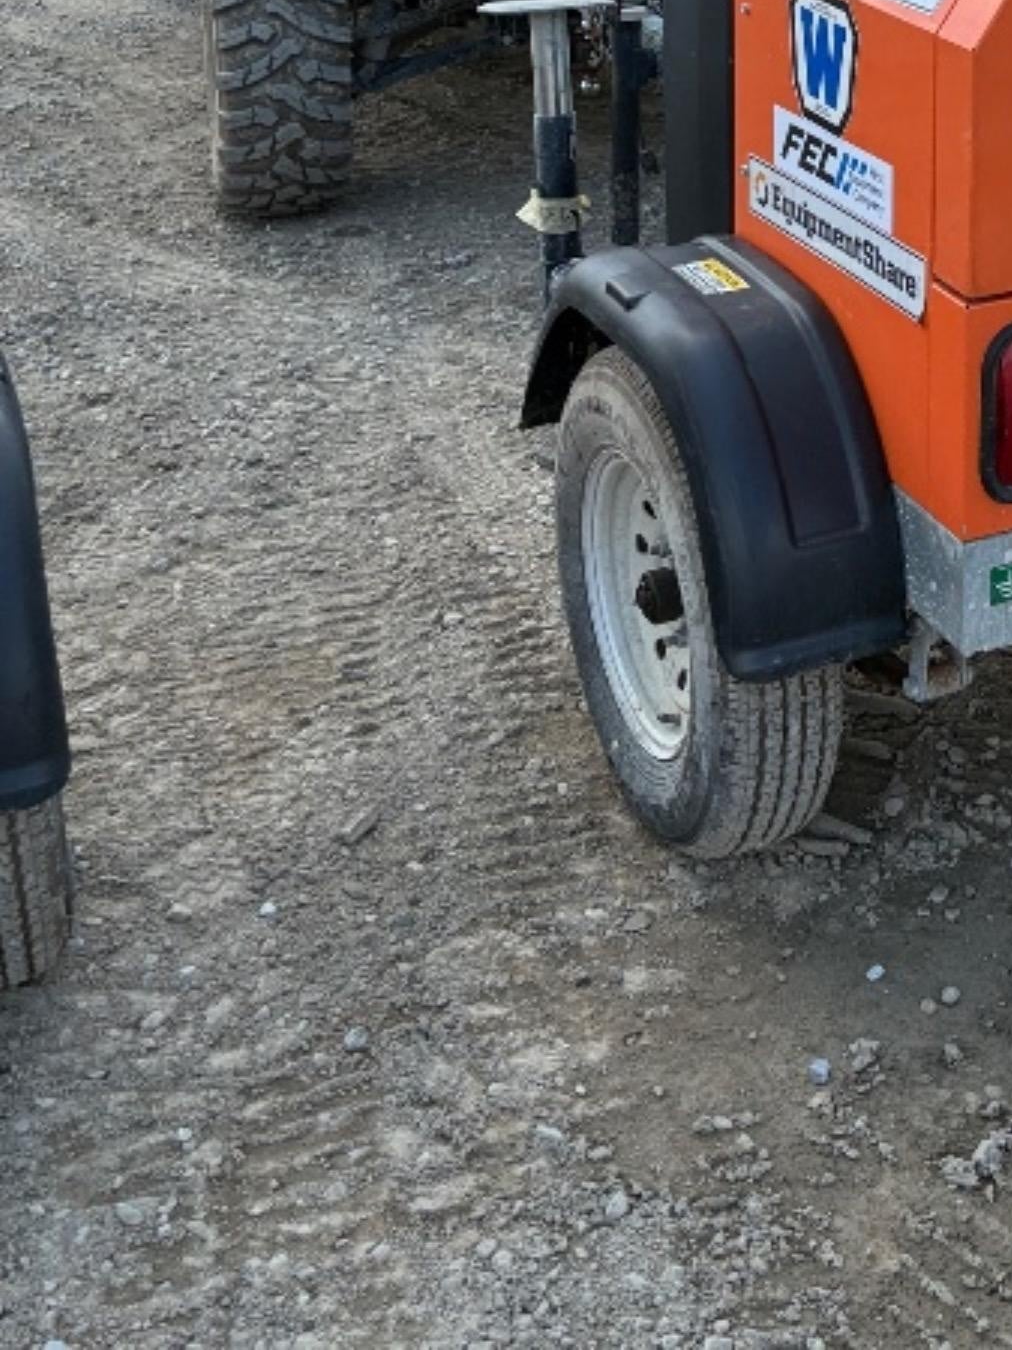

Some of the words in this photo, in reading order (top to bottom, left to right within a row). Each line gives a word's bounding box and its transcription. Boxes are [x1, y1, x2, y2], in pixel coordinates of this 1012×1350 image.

[800, 5, 847, 112] W
[780, 123, 838, 188] FEC
[770, 180, 917, 299] EquipmentShare
